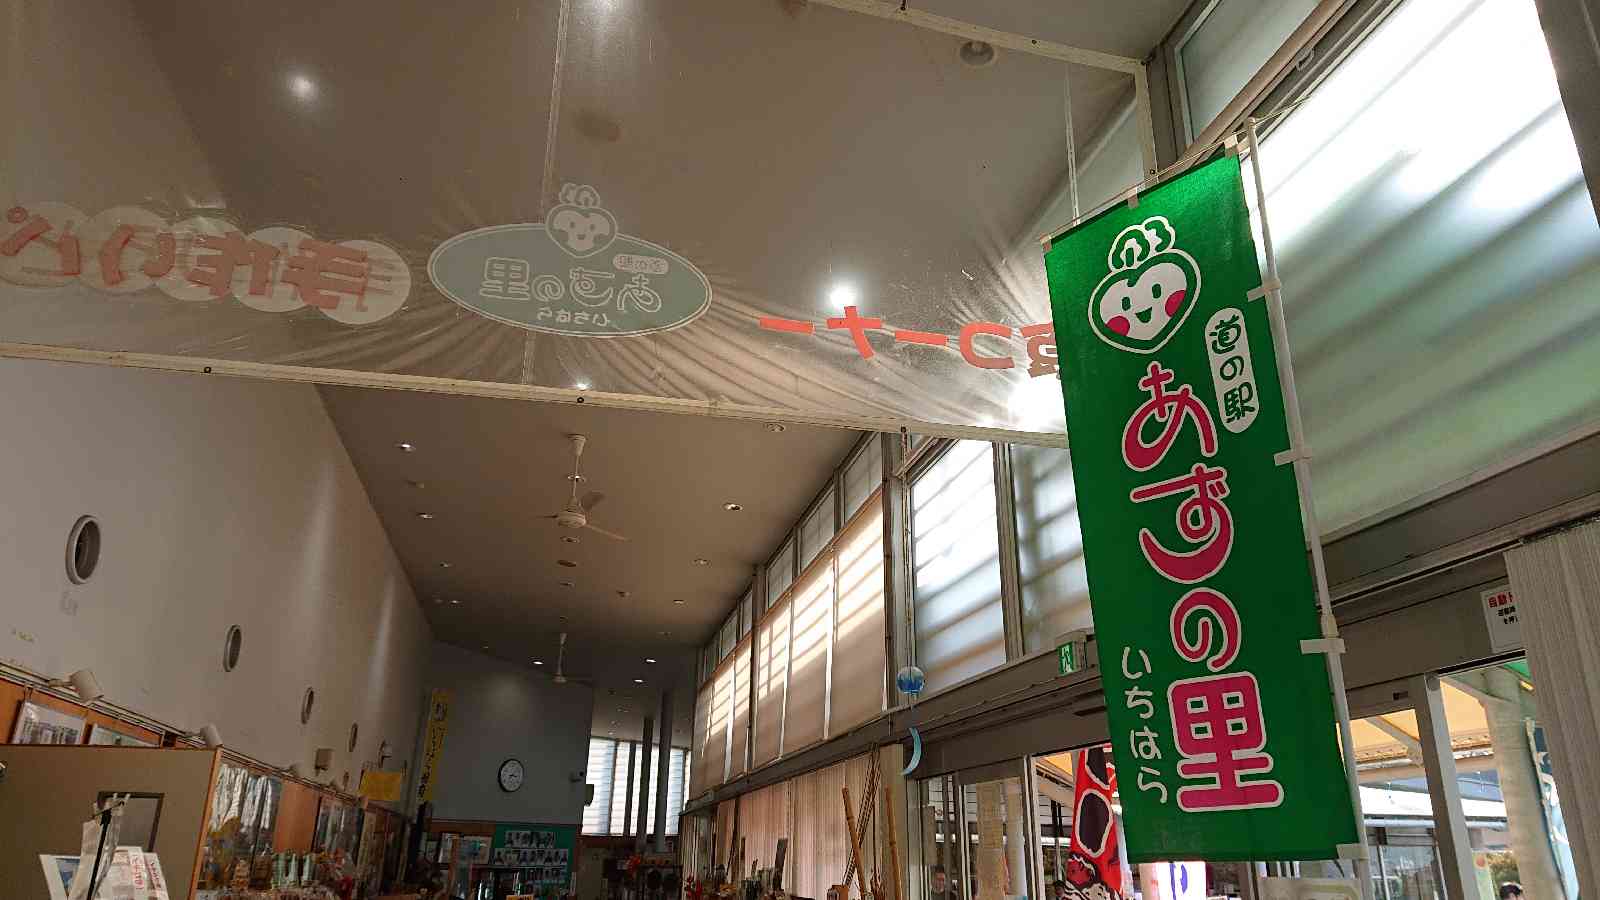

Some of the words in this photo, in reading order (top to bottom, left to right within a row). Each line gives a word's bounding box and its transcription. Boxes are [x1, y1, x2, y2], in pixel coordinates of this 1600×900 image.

[1208, 313, 1256, 424] 道の駅
[1121, 360, 1286, 813] あずの里
[1121, 646, 1169, 804] いちはら
